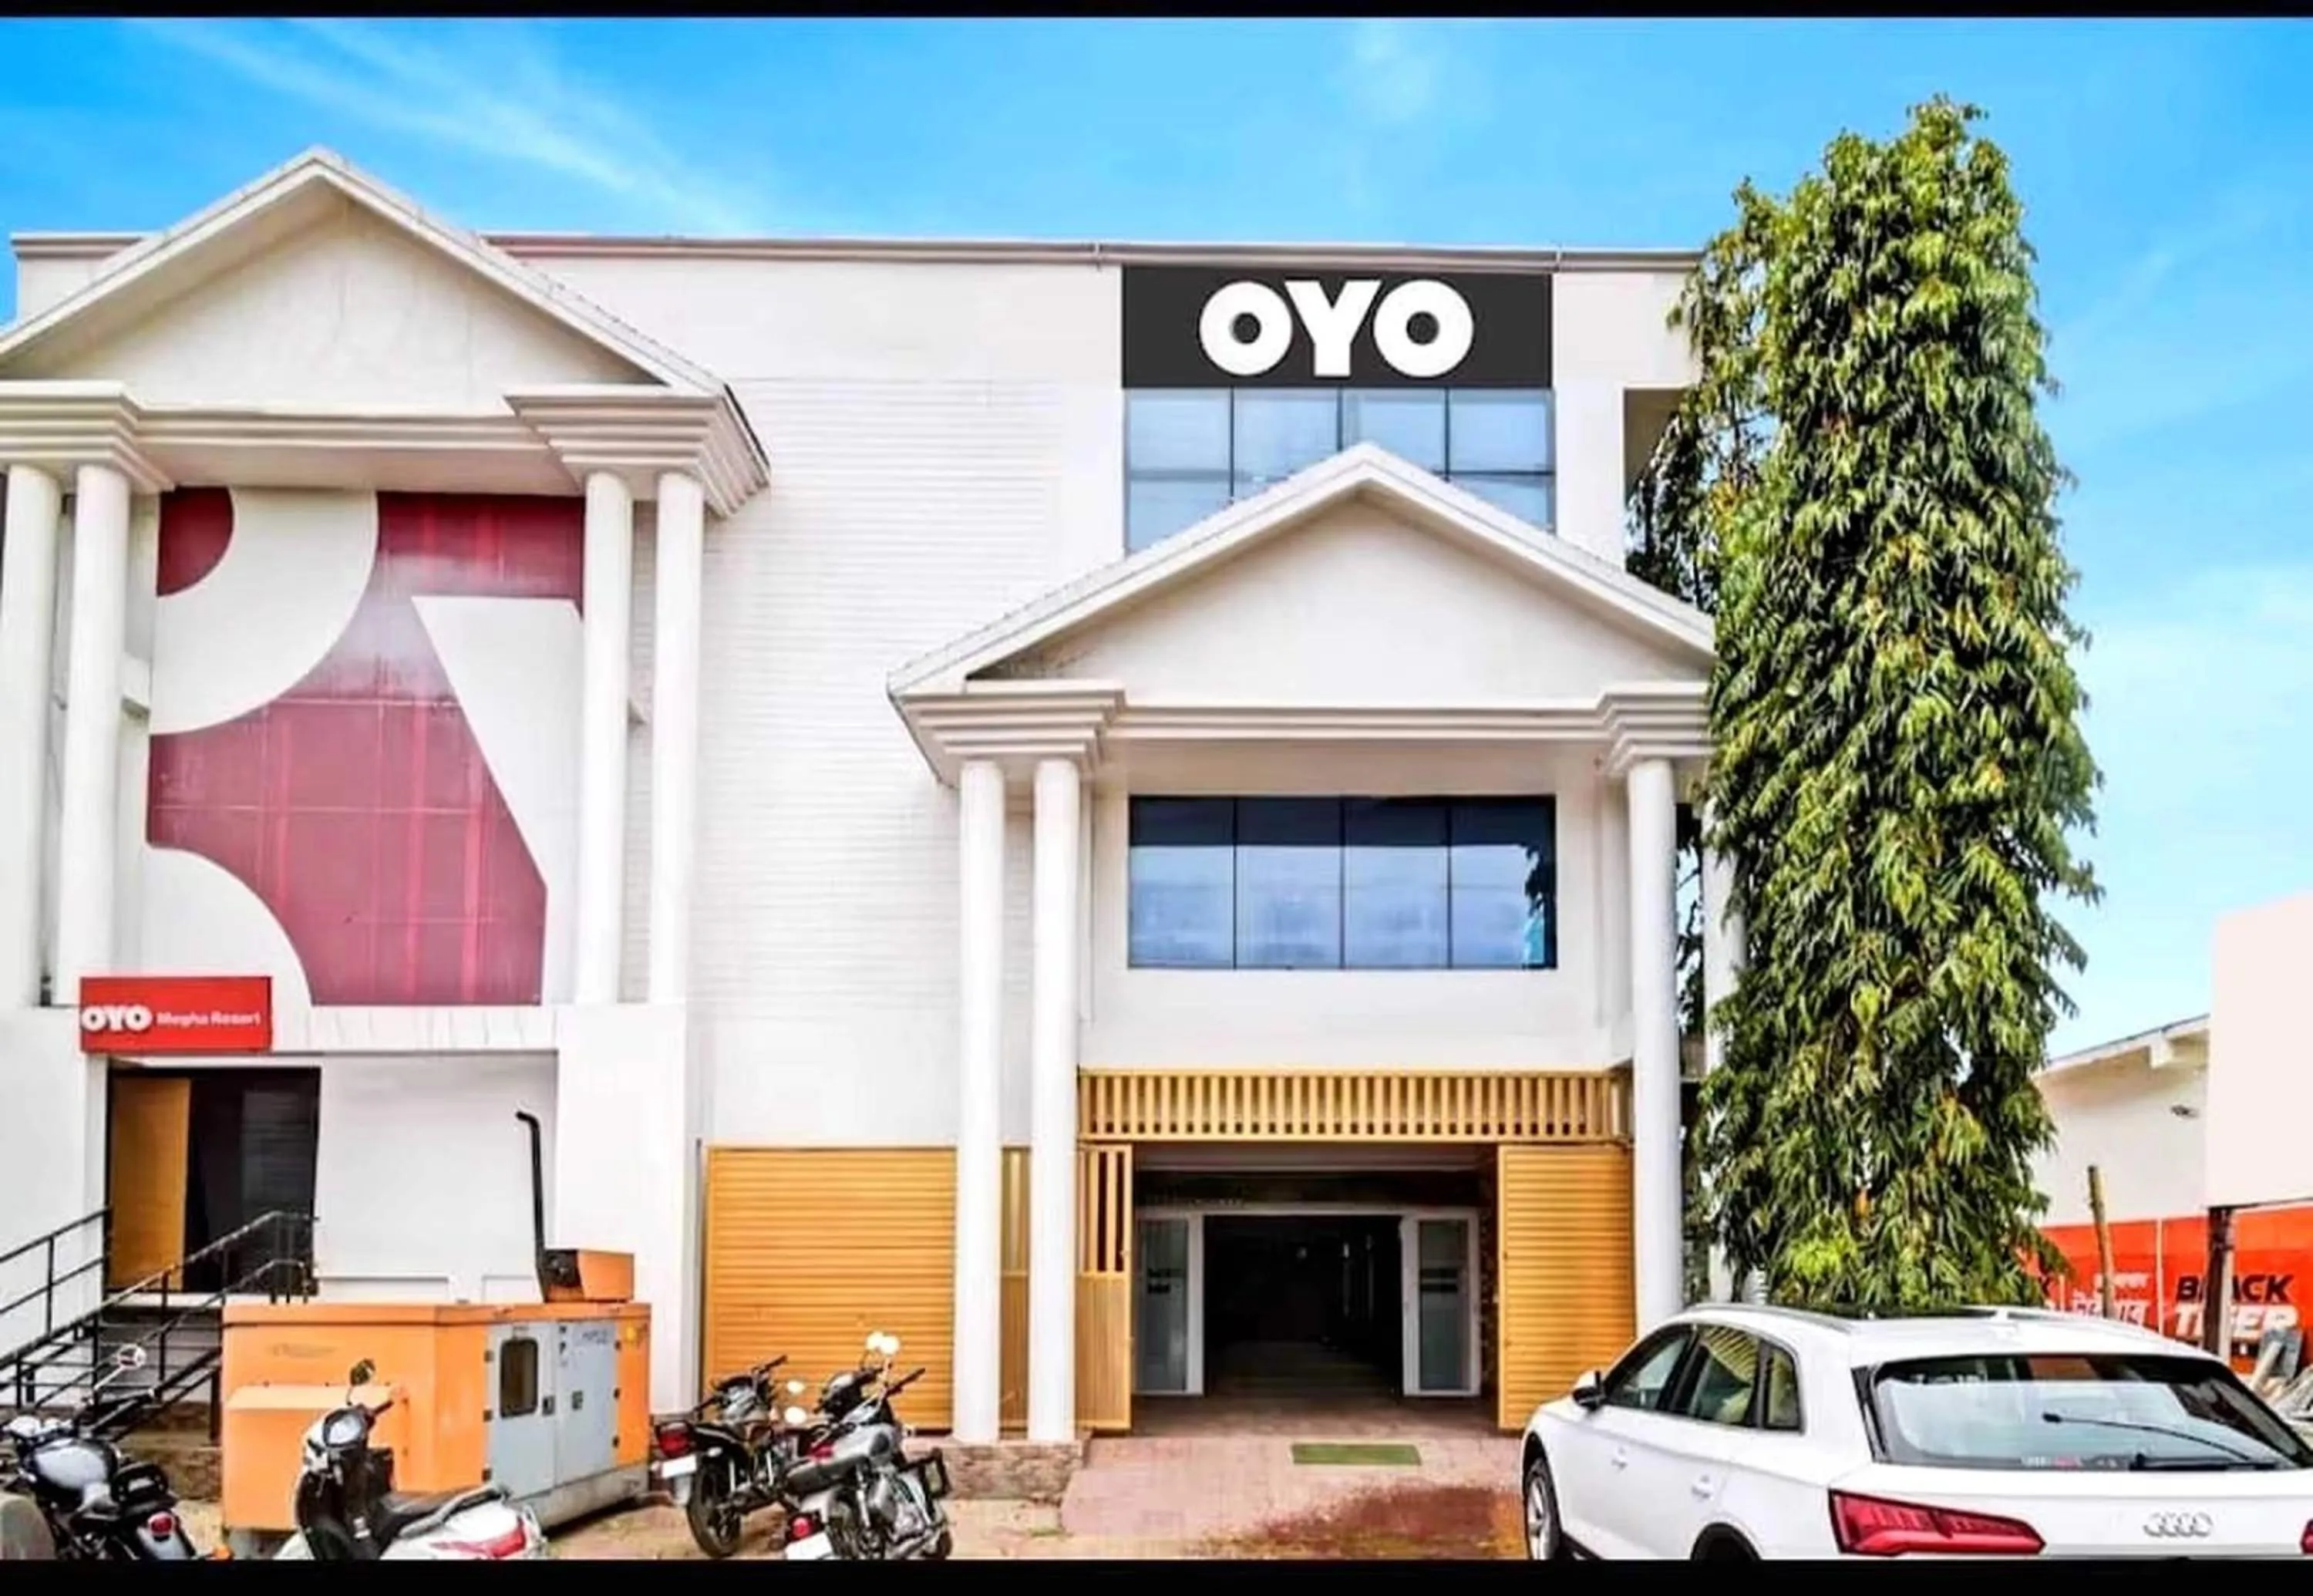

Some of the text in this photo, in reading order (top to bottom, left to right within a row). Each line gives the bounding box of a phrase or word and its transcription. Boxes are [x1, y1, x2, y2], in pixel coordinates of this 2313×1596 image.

[1198, 279, 1475, 378] OYO
[80, 1004, 152, 1032] OYO
[210, 1010, 261, 1026] Resort
[2174, 1301, 2299, 1338] TIER
